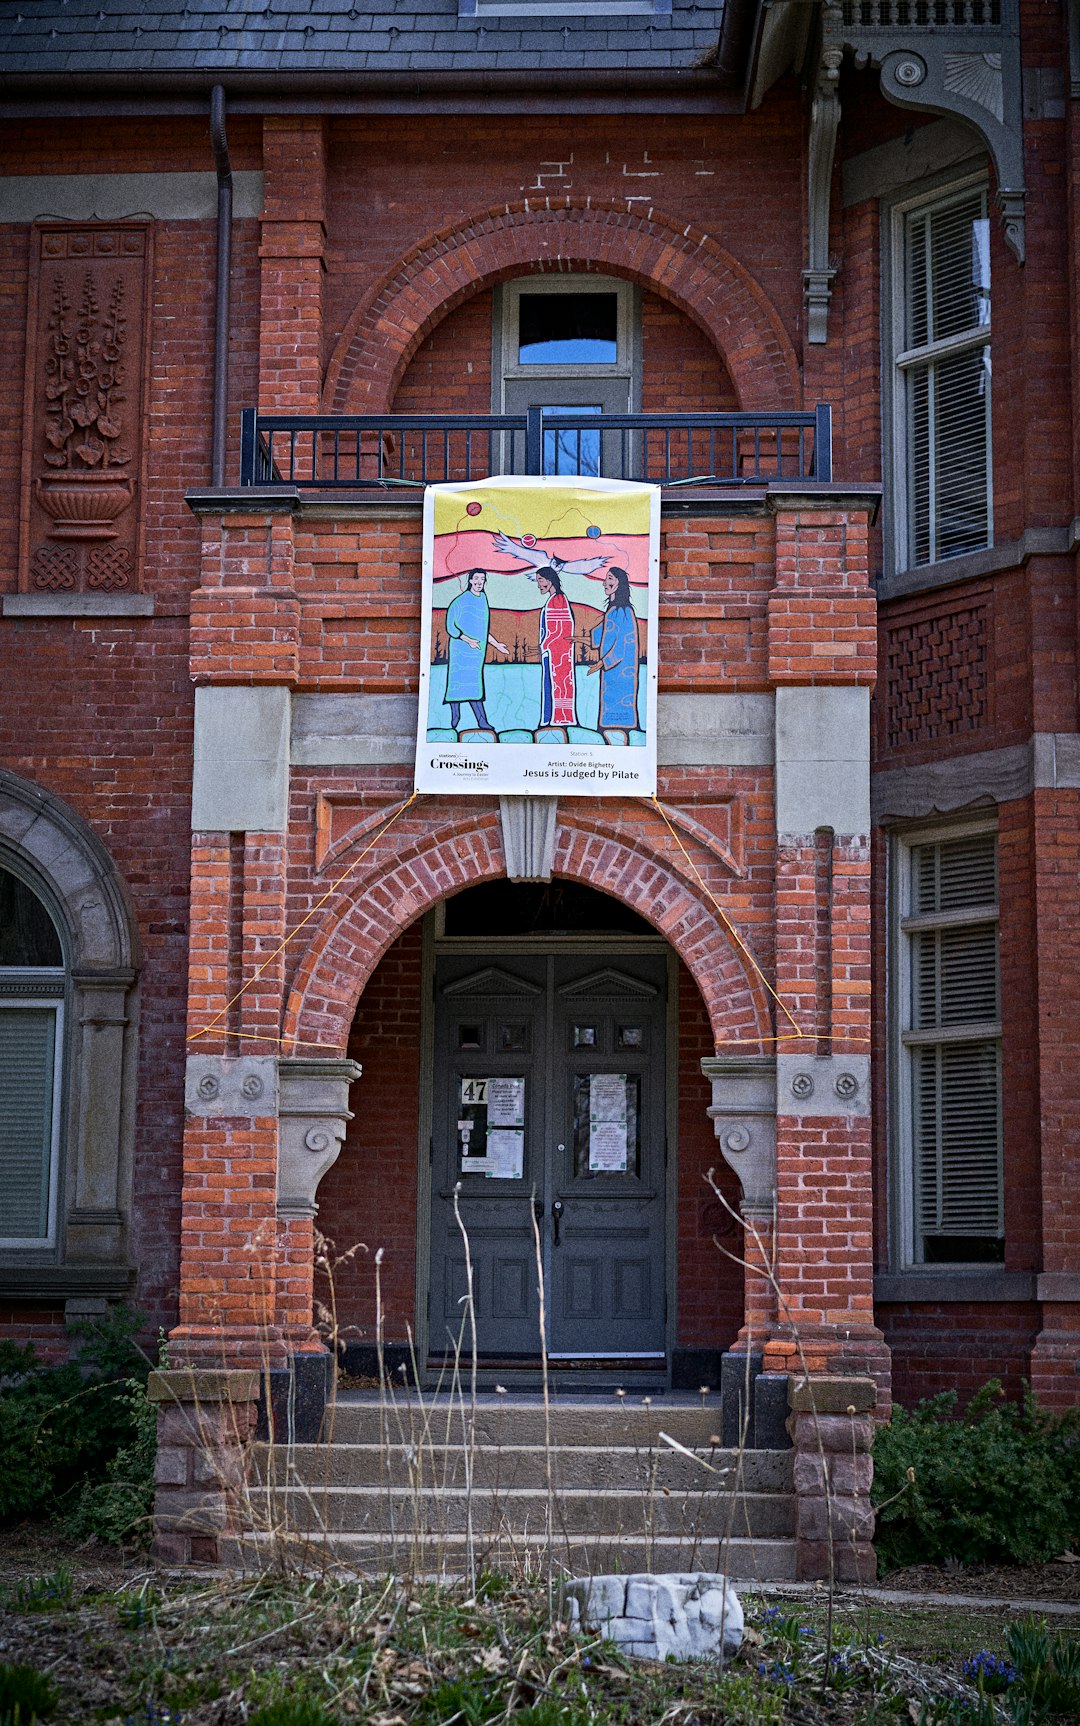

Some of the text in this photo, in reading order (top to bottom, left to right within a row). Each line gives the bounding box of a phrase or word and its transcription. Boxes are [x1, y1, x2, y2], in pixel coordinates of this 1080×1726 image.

[430, 758, 488, 772] Crossings
[522, 769, 640, 780] Jesus is Judged by Pilate
[464, 1082, 486, 1100] 47
